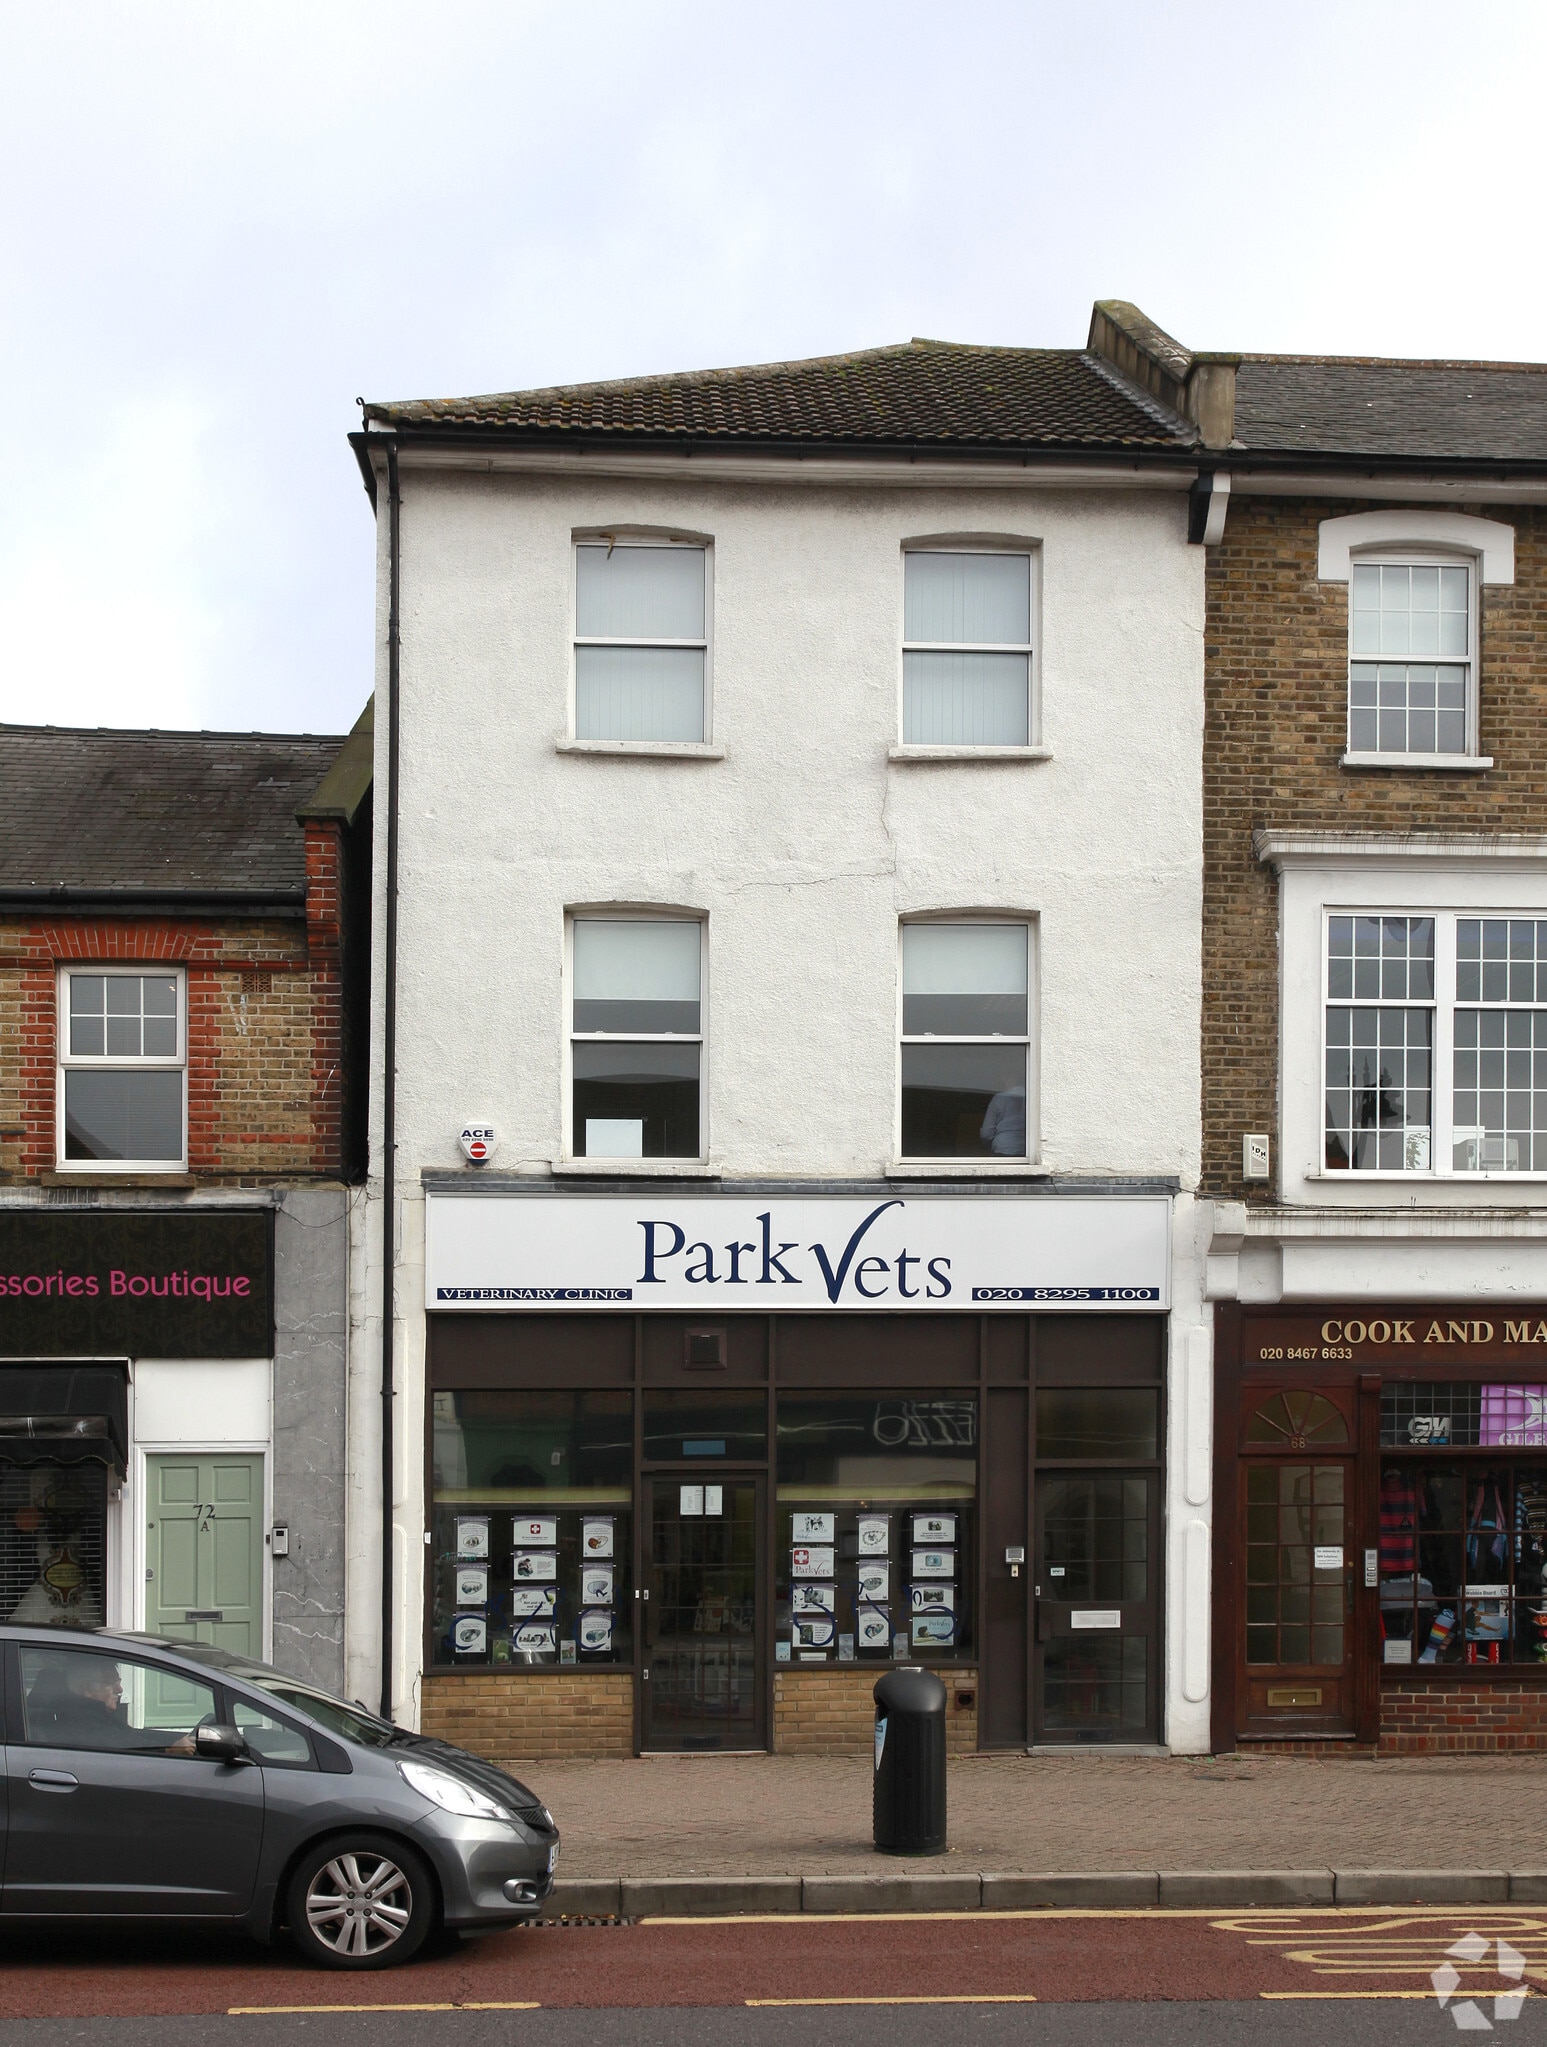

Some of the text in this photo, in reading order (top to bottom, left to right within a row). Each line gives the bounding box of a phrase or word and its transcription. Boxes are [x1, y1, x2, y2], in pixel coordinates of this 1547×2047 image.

[461, 1129, 494, 1138] ACE
[109, 1270, 250, 1302] Boutique
[442, 1289, 628, 1300] VETERINARY CLINIC
[977, 1288, 1152, 1300] 020 8295 1100
[1321, 1320, 1547, 1344] COOK AND MA
[1260, 1347, 1353, 1360] 020 8467 6633
[1291, 1437, 1306, 1449] 68
[193, 1504, 216, 1519] 72
[200, 1520, 210, 1532] A
